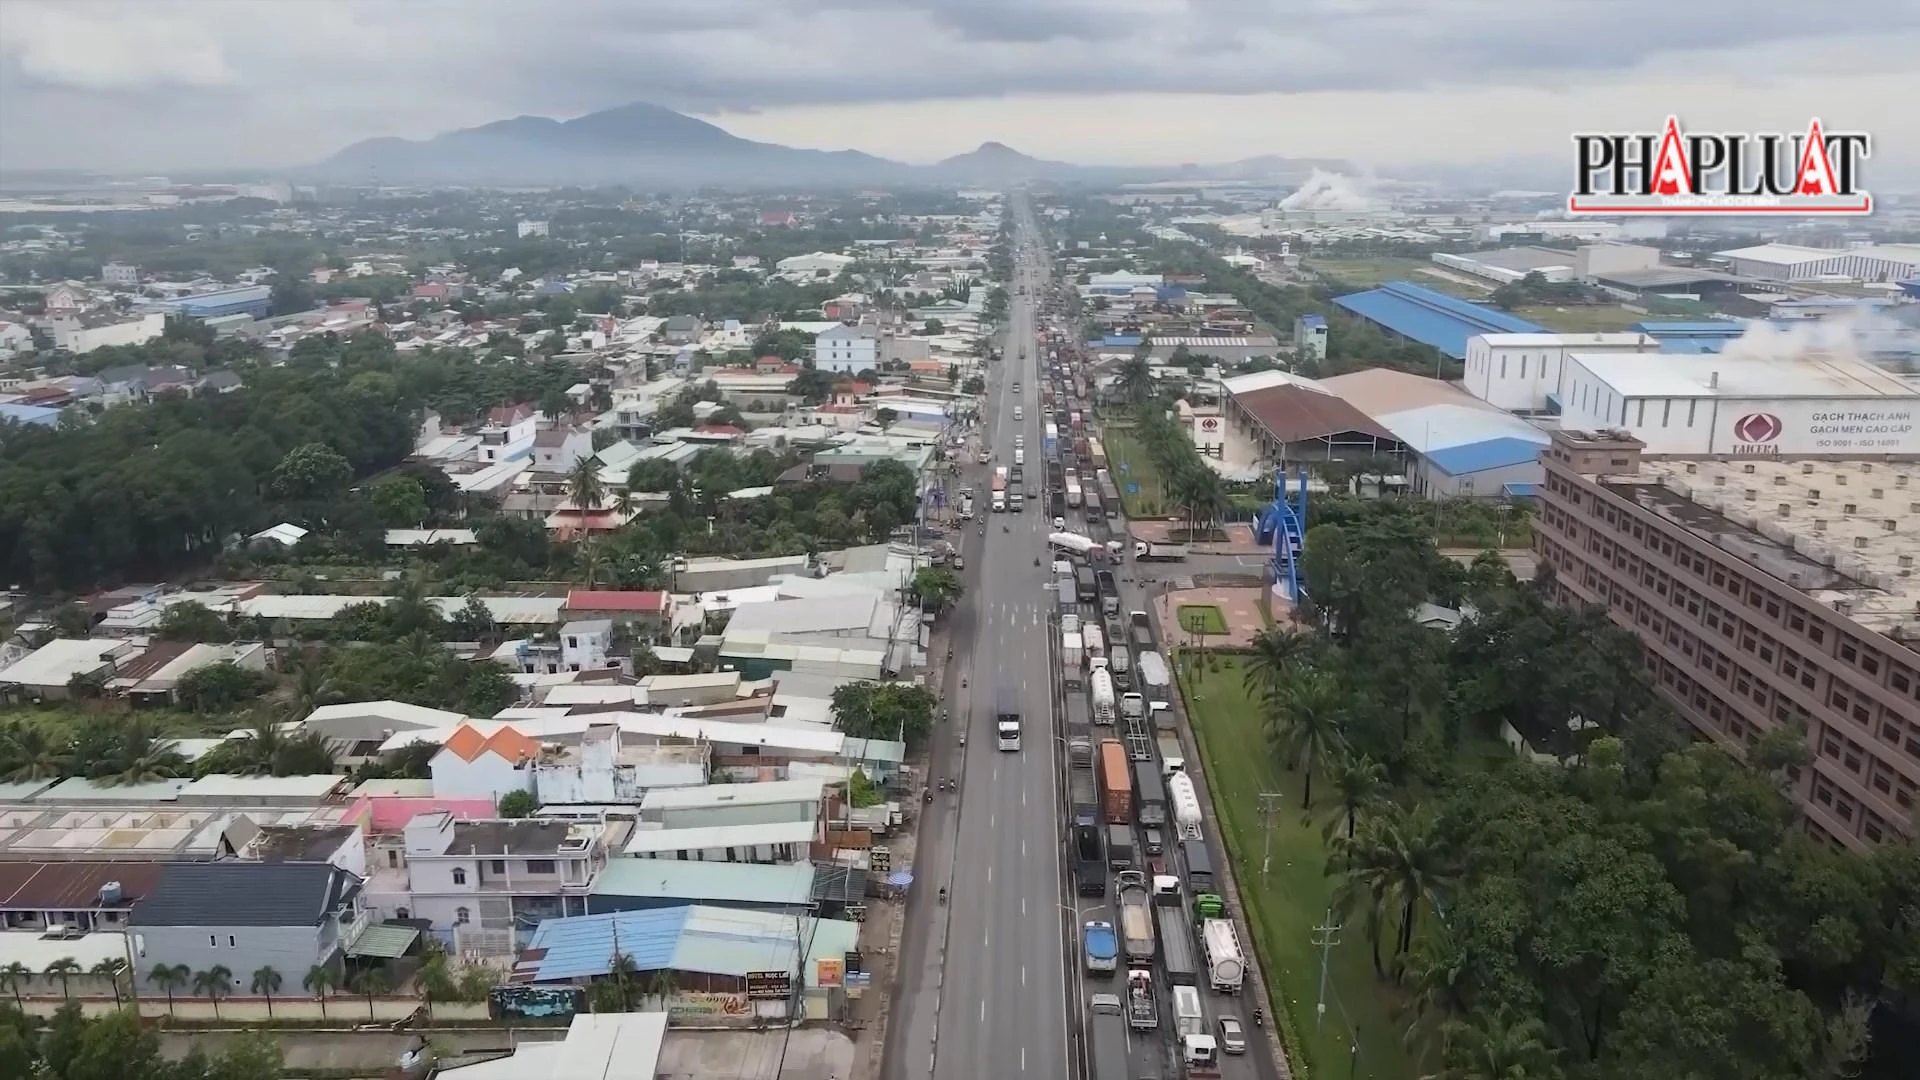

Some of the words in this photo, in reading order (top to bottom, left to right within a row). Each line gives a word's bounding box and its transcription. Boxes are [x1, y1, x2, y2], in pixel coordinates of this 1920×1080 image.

[1812, 412, 1844, 423] GẠCH
[1848, 412, 1884, 423] THẠCH
[1866, 425, 1889, 433] CAO
[1816, 439, 1831, 447] ISO
[1859, 439, 1875, 447] ISO
